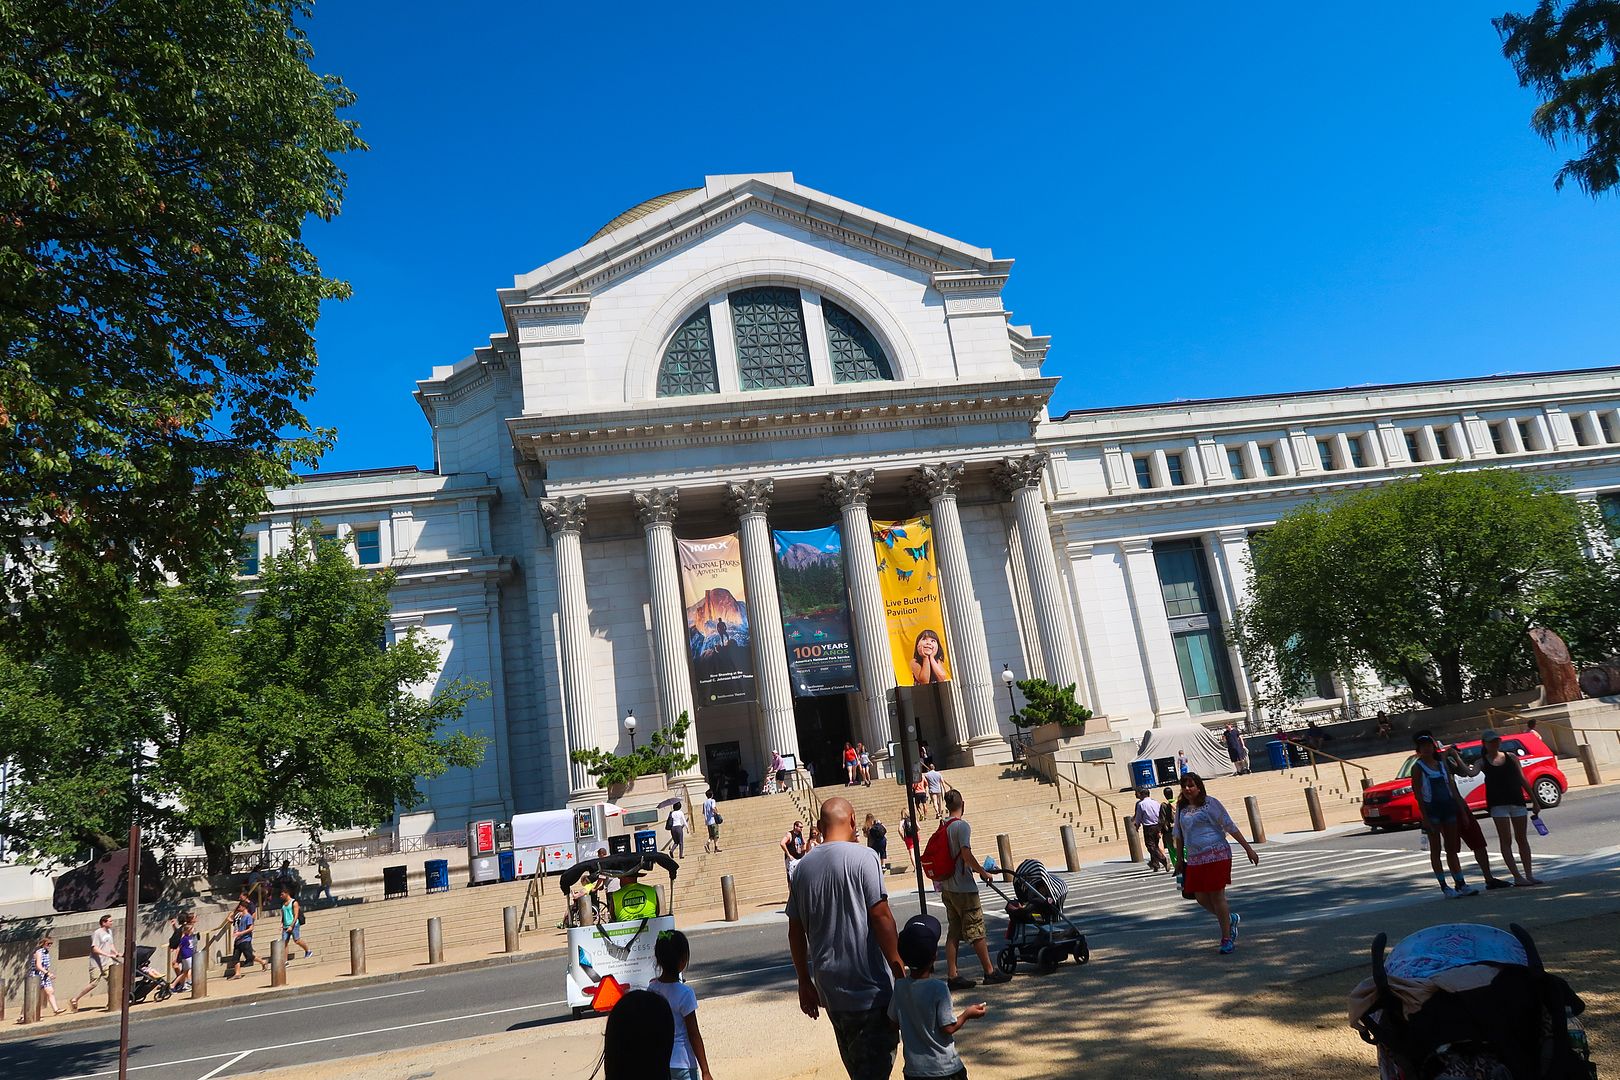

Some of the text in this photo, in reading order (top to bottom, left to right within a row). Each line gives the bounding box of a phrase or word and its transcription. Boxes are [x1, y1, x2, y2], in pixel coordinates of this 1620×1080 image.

[690, 541, 728, 553] IMAX
[885, 594, 938, 607] Live Butterfly
[886, 607, 918, 617] Pavilion
[793, 642, 849, 659] 100 YEARS
